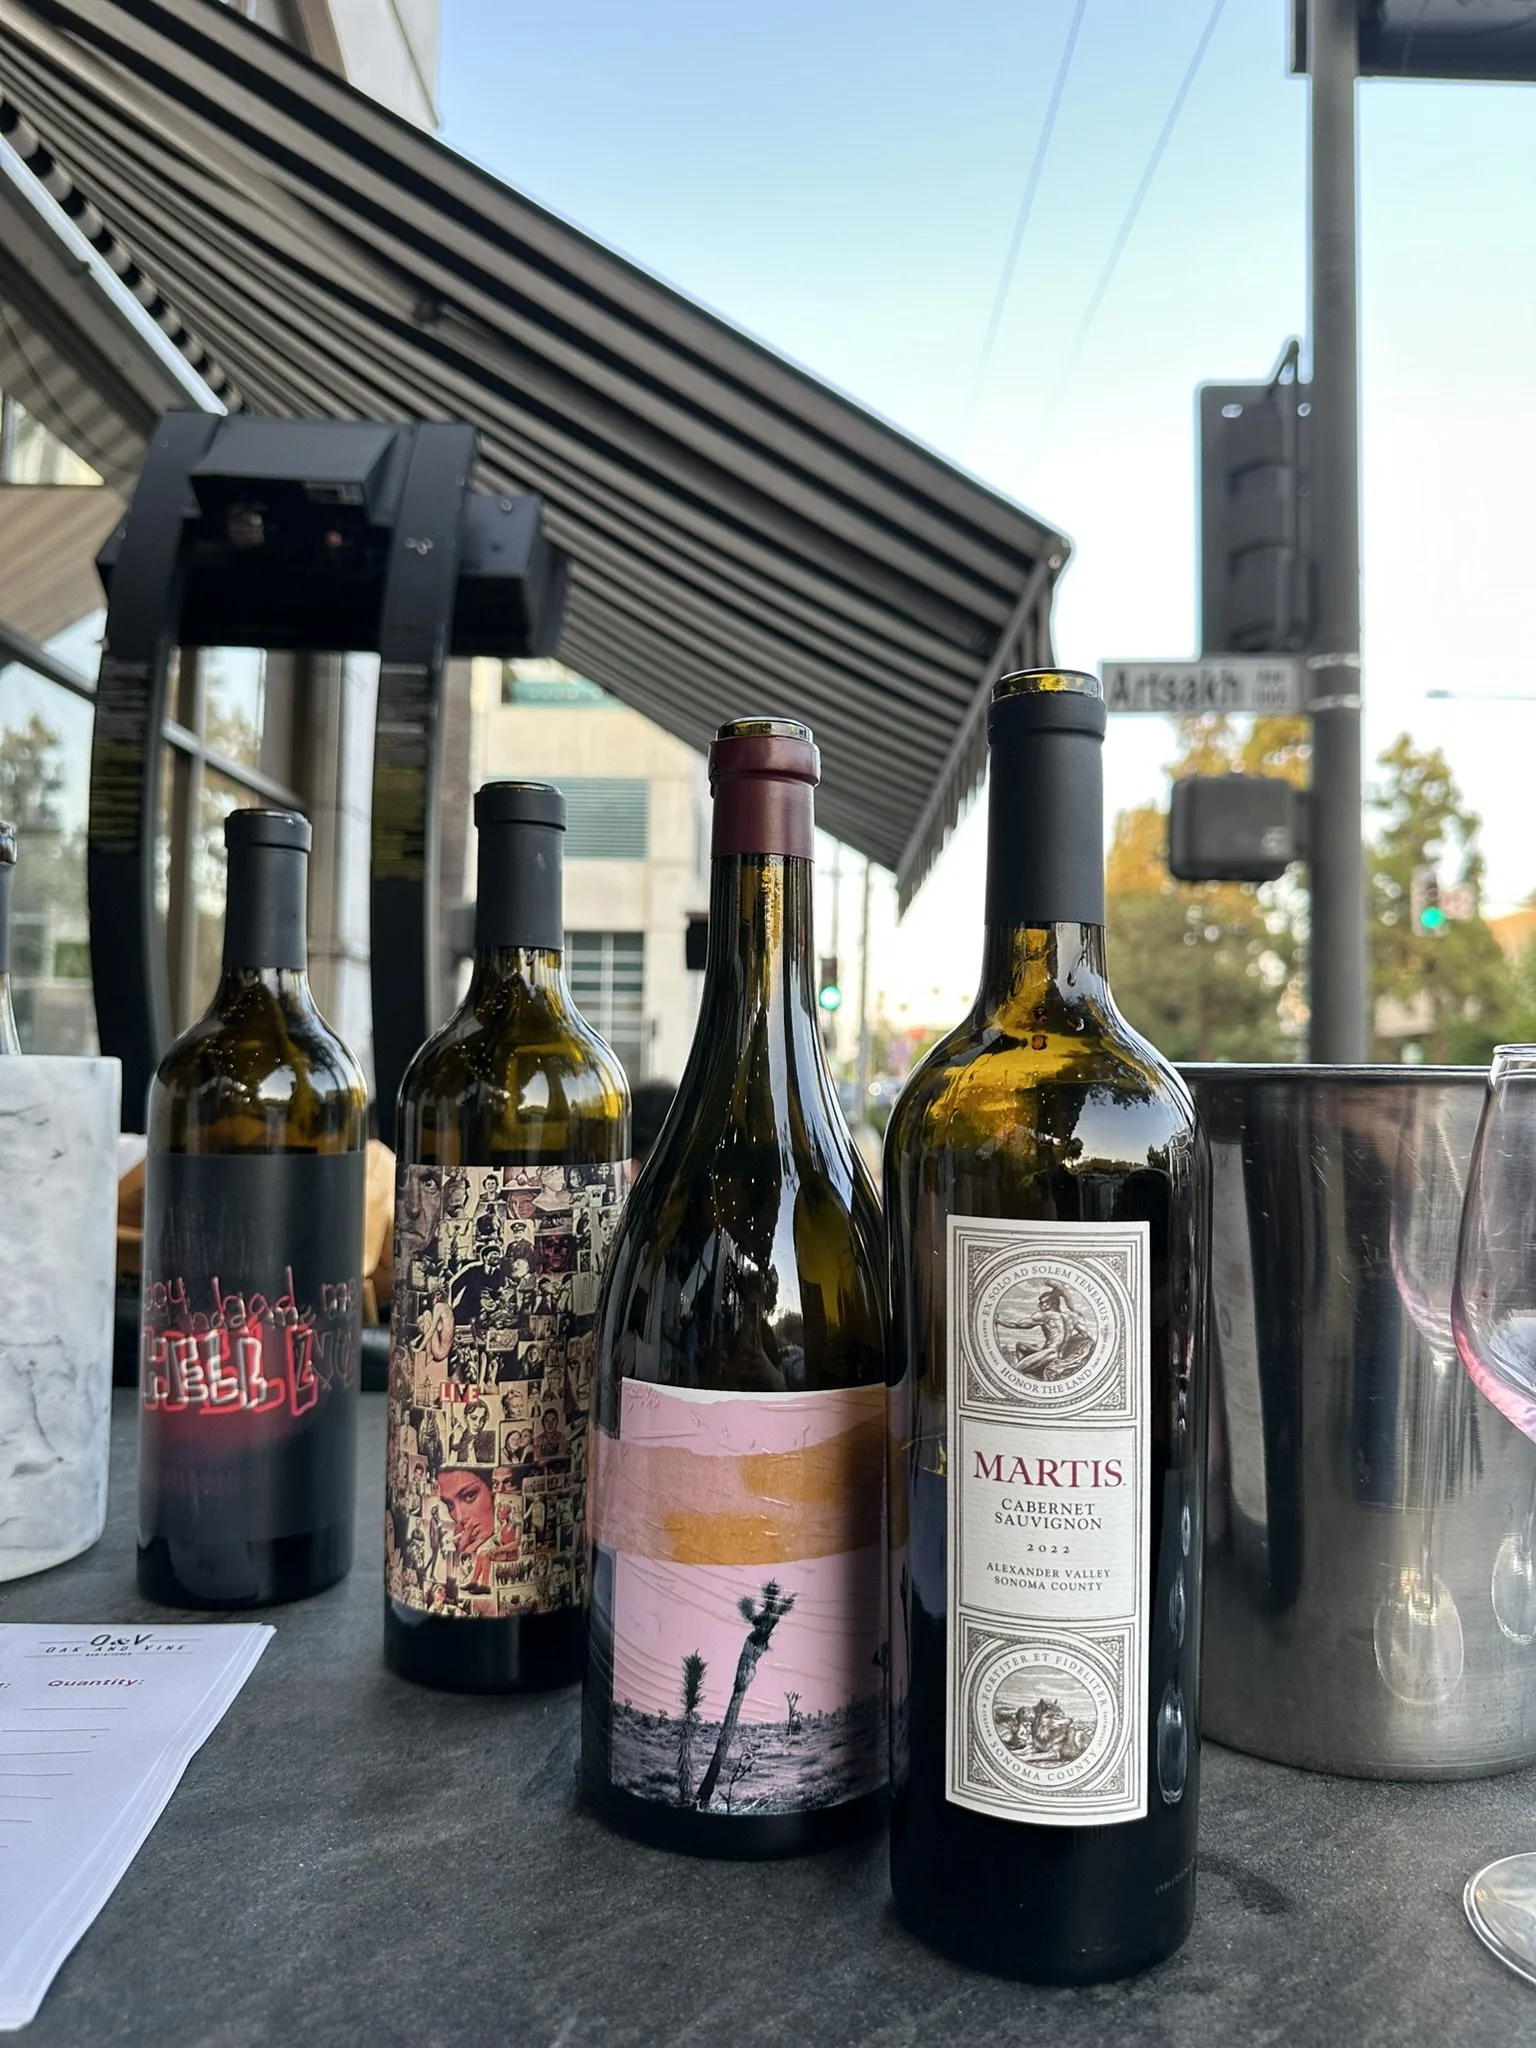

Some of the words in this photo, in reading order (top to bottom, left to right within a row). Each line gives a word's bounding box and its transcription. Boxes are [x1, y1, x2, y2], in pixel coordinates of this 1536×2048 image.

[982, 1301, 993, 1317] EX
[989, 1276, 1012, 1301] SOLO
[1013, 1267, 1029, 1280] AD
[1031, 1265, 1073, 1279] SOLEM
[1073, 1273, 1110, 1321] TENEMUS
[1001, 1367, 1039, 1393] HONOR
[1041, 1385, 1064, 1394] THE
[1065, 1368, 1092, 1391] LAND
[973, 1450, 1123, 1488] MARTIS
[1001, 1498, 1096, 1515] CABERNET
[994, 1512, 1102, 1530] SAUVIGNON
[1026, 1543, 1071, 1554] 2022
[986, 1561, 1060, 1578] ALEXANDER
[1065, 1568, 1111, 1578] VALLEY
[994, 1575, 1046, 1590] SONOMA
[1051, 1581, 1103, 1591] COUNTY
[47, 1678, 145, 1688] Quantity:
[982, 1654, 1028, 1700] FORTITER
[1033, 1653, 1050, 1662] ET
[1056, 1655, 1108, 1706] FIDELITER
[990, 1740, 1040, 1780] SONOMA
[1047, 1751, 1097, 1781] COUNTY
